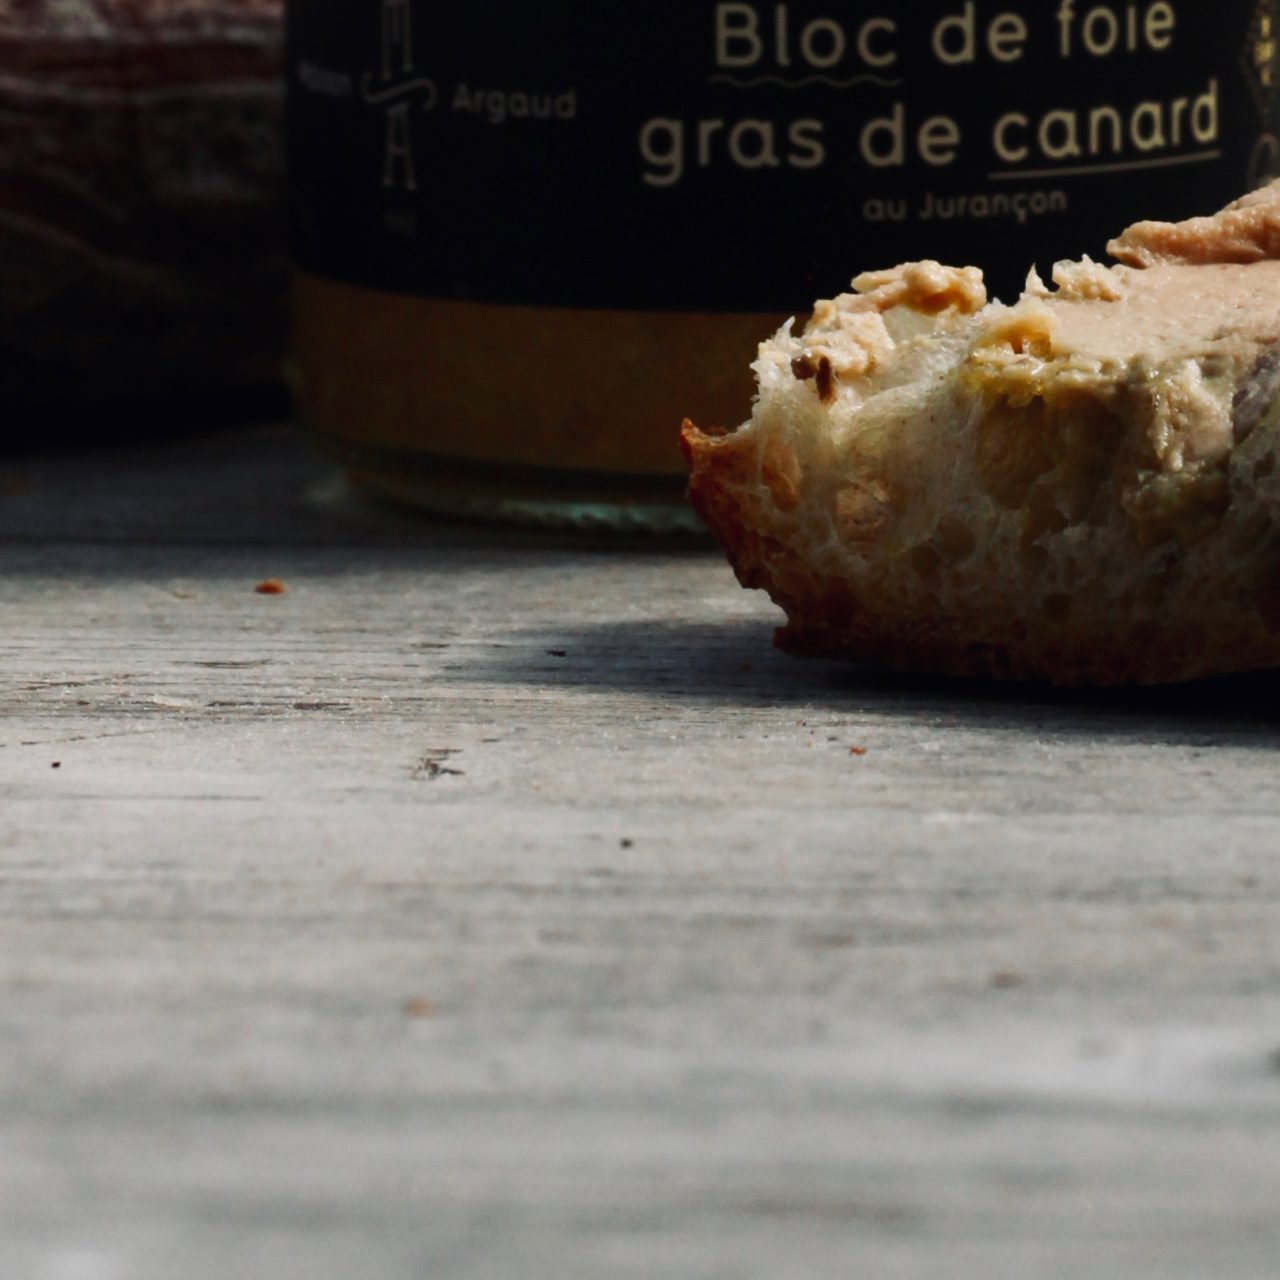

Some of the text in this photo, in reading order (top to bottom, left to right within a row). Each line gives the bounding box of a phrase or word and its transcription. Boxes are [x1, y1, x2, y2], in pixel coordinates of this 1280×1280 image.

[713, 1, 898, 70] Bloc
[451, 82, 577, 125] Argaud
[637, 77, 1220, 188] gras de canard
[862, 188, 1067, 225] au Jurançon
